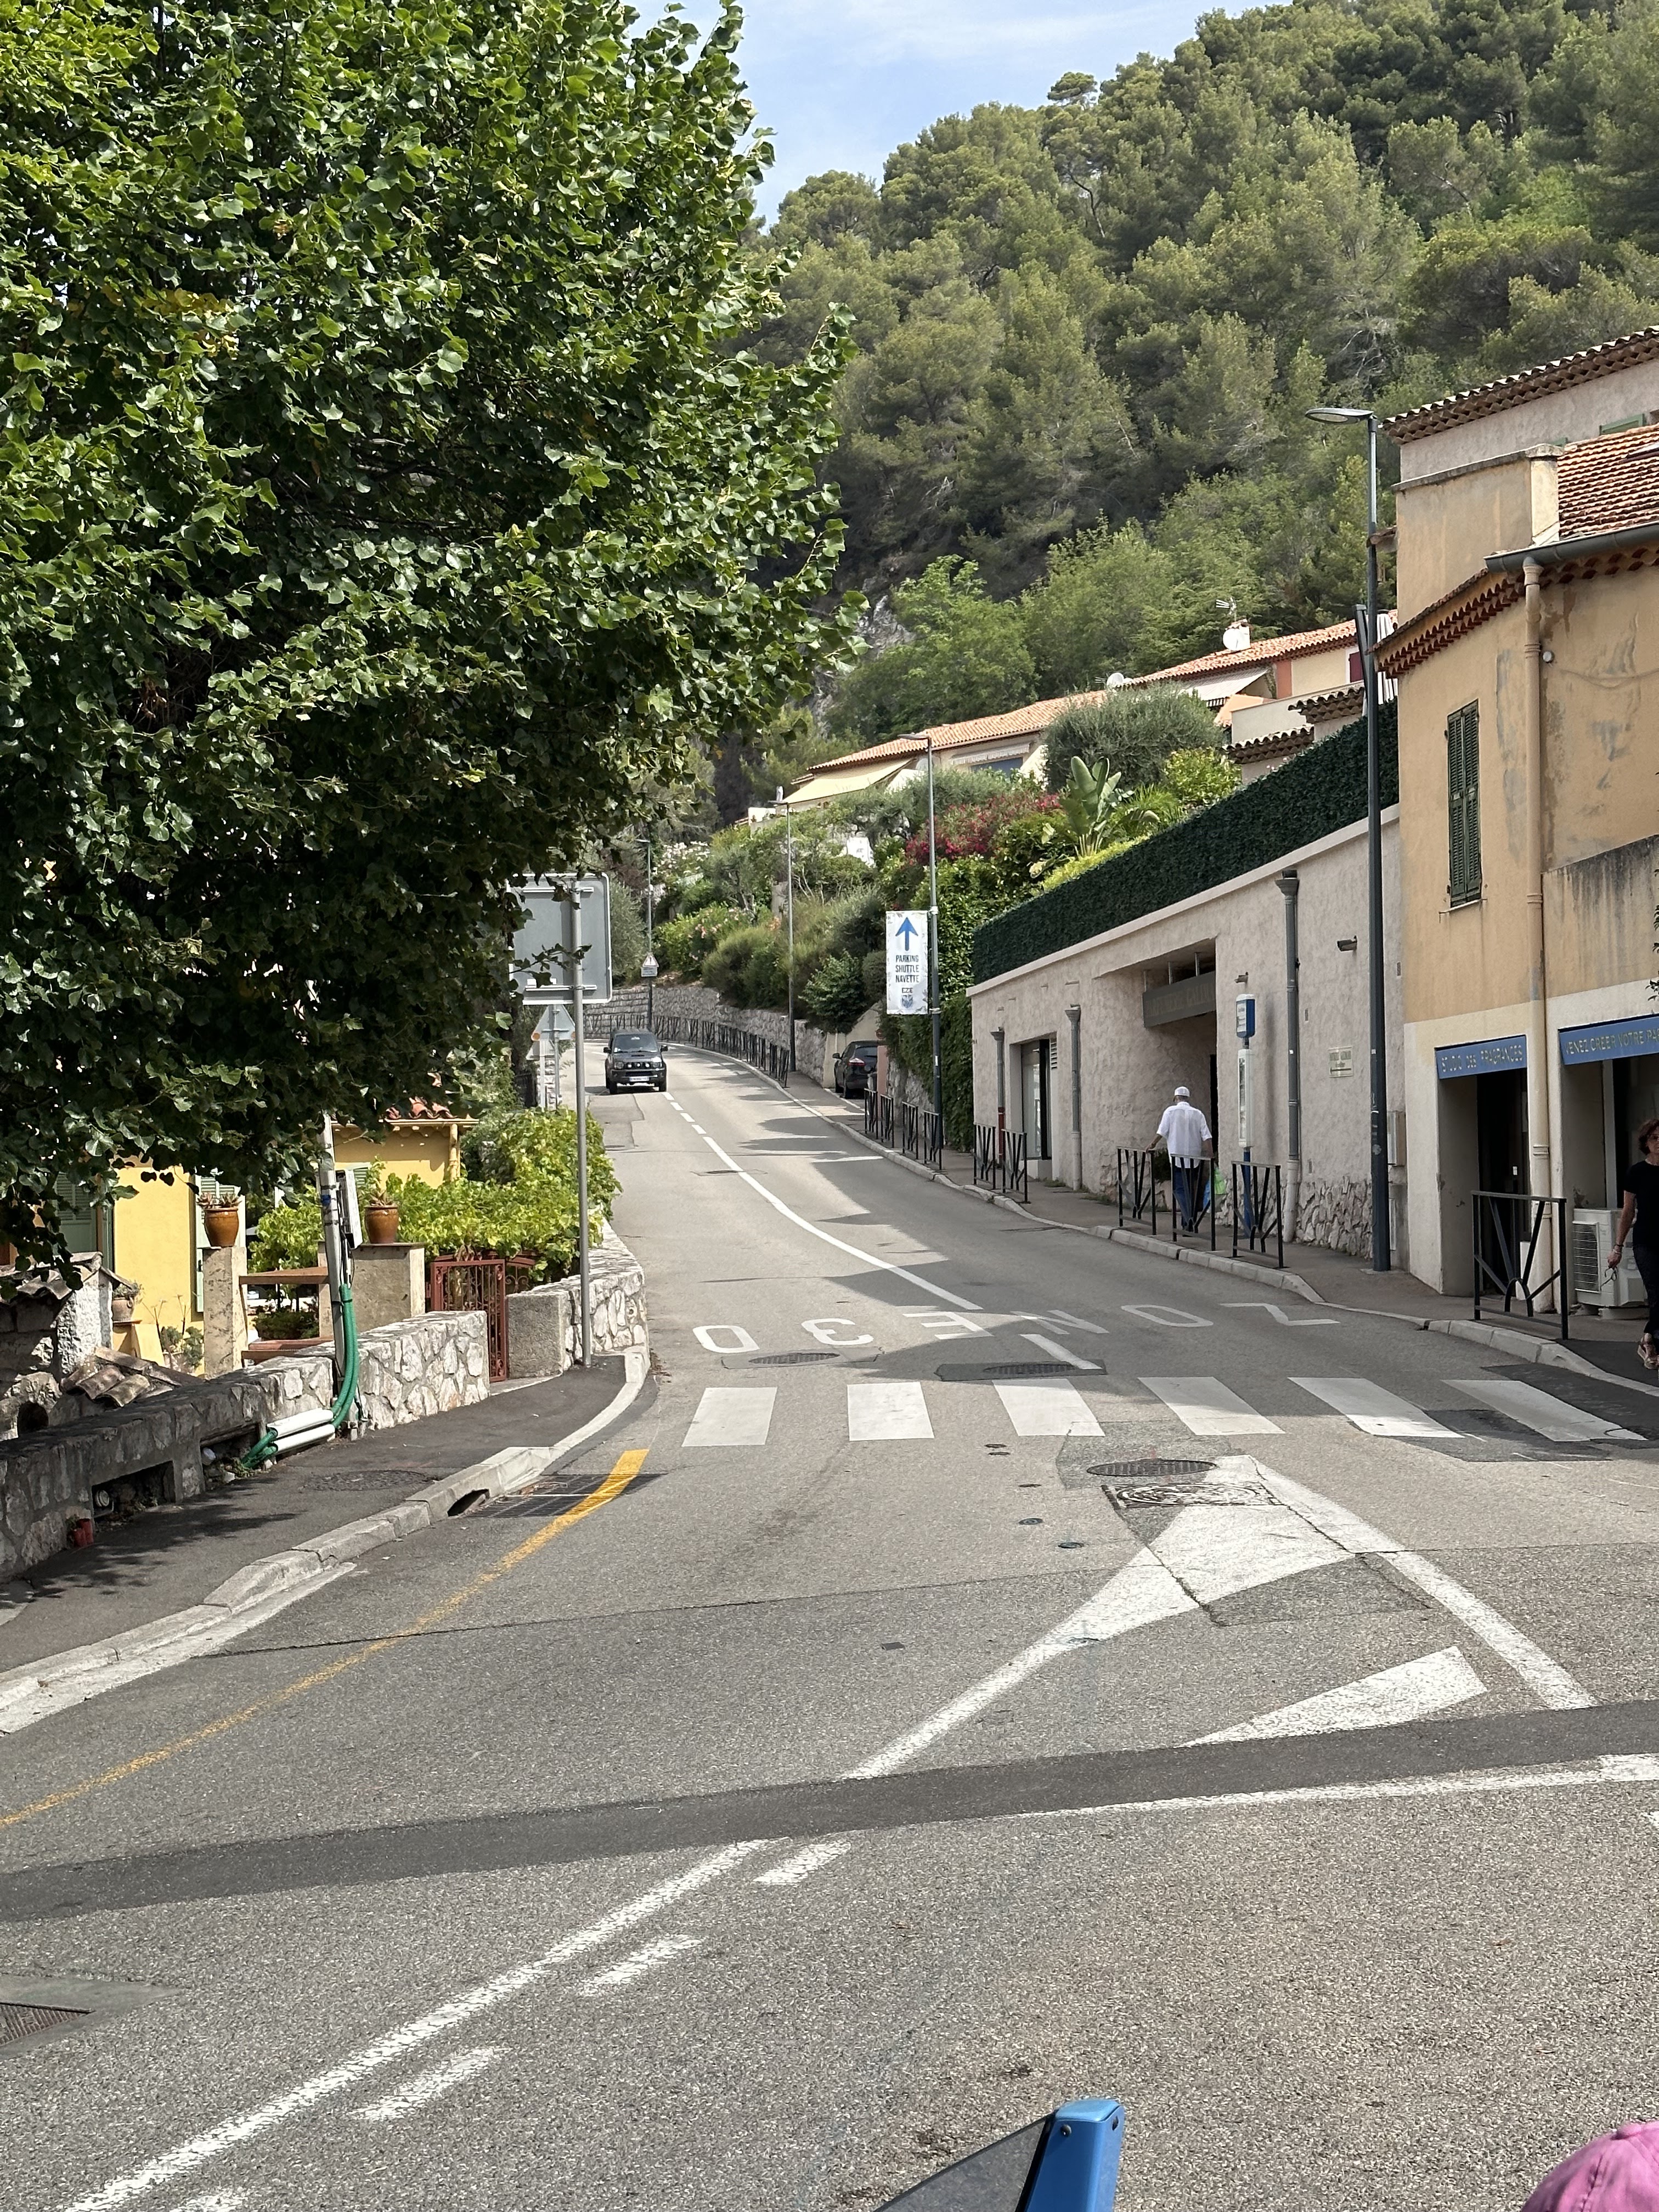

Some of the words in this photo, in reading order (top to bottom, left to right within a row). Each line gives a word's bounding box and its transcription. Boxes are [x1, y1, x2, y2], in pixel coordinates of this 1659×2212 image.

[895, 955, 919, 963] PARKING
[895, 964, 919, 973] SHUTTLE
[895, 974, 919, 983] NAVETTE
[1565, 1039, 1589, 1055] VENEZ
[1618, 1030, 1645, 1047] VOTRE
[1466, 1054, 1477, 1069] DES
[1480, 1045, 1523, 1065] FRAGRANCES
[902, 1303, 1340, 1340] ZONE
[692, 1318, 874, 1354] 30
